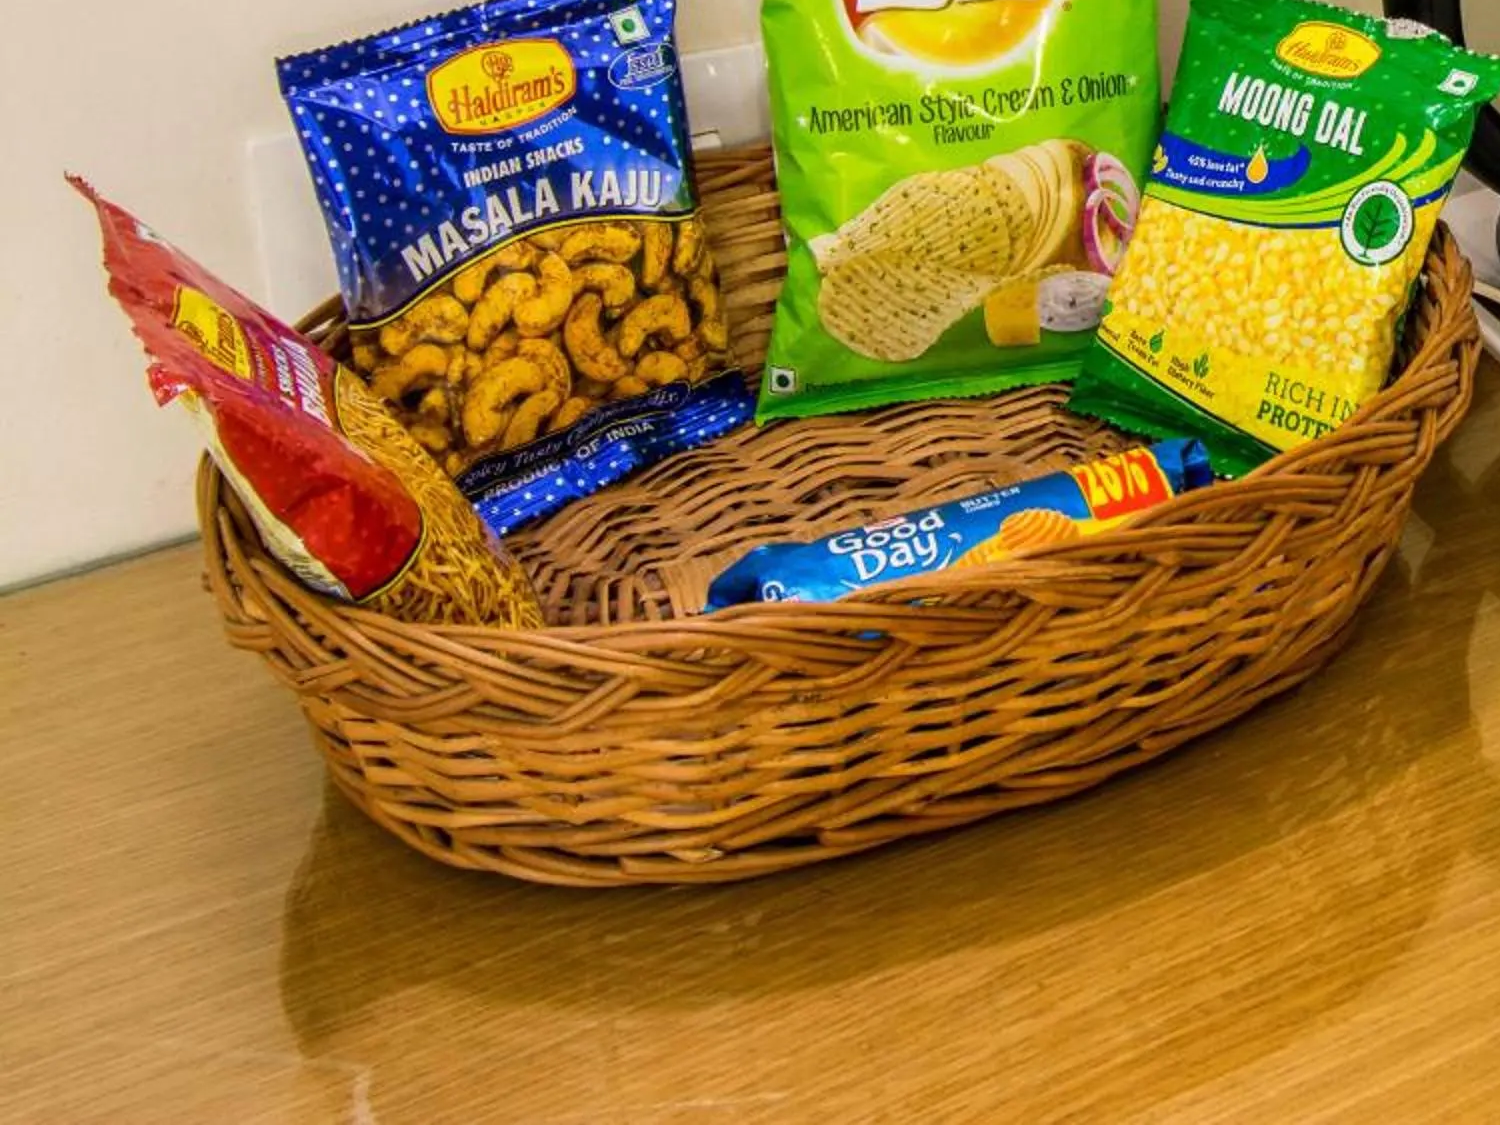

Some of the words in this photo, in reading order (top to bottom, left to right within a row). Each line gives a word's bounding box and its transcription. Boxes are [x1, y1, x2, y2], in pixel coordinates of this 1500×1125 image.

[448, 65, 566, 125] Haldiram's
[809, 101, 912, 135] American
[919, 92, 975, 126] Style
[983, 84, 1055, 115] Cream
[1078, 71, 1127, 105] Onion
[1217, 71, 1314, 139] MOONG
[1316, 98, 1366, 156] DAL
[451, 141, 494, 154] TASTE
[497, 137, 514, 150] OF
[517, 105, 578, 144] TRADITION
[933, 123, 995, 145] Flavour
[463, 156, 522, 188] INDIAN
[525, 136, 585, 169] SNACKS
[399, 177, 561, 283] MASALA
[571, 169, 663, 211] KAJU
[1264, 371, 1326, 413] RICH
[576, 439, 601, 459] OF
[605, 421, 655, 444] INDIA
[1256, 399, 1337, 440] PROTE
[827, 509, 946, 555] Good
[850, 531, 939, 581] Day
